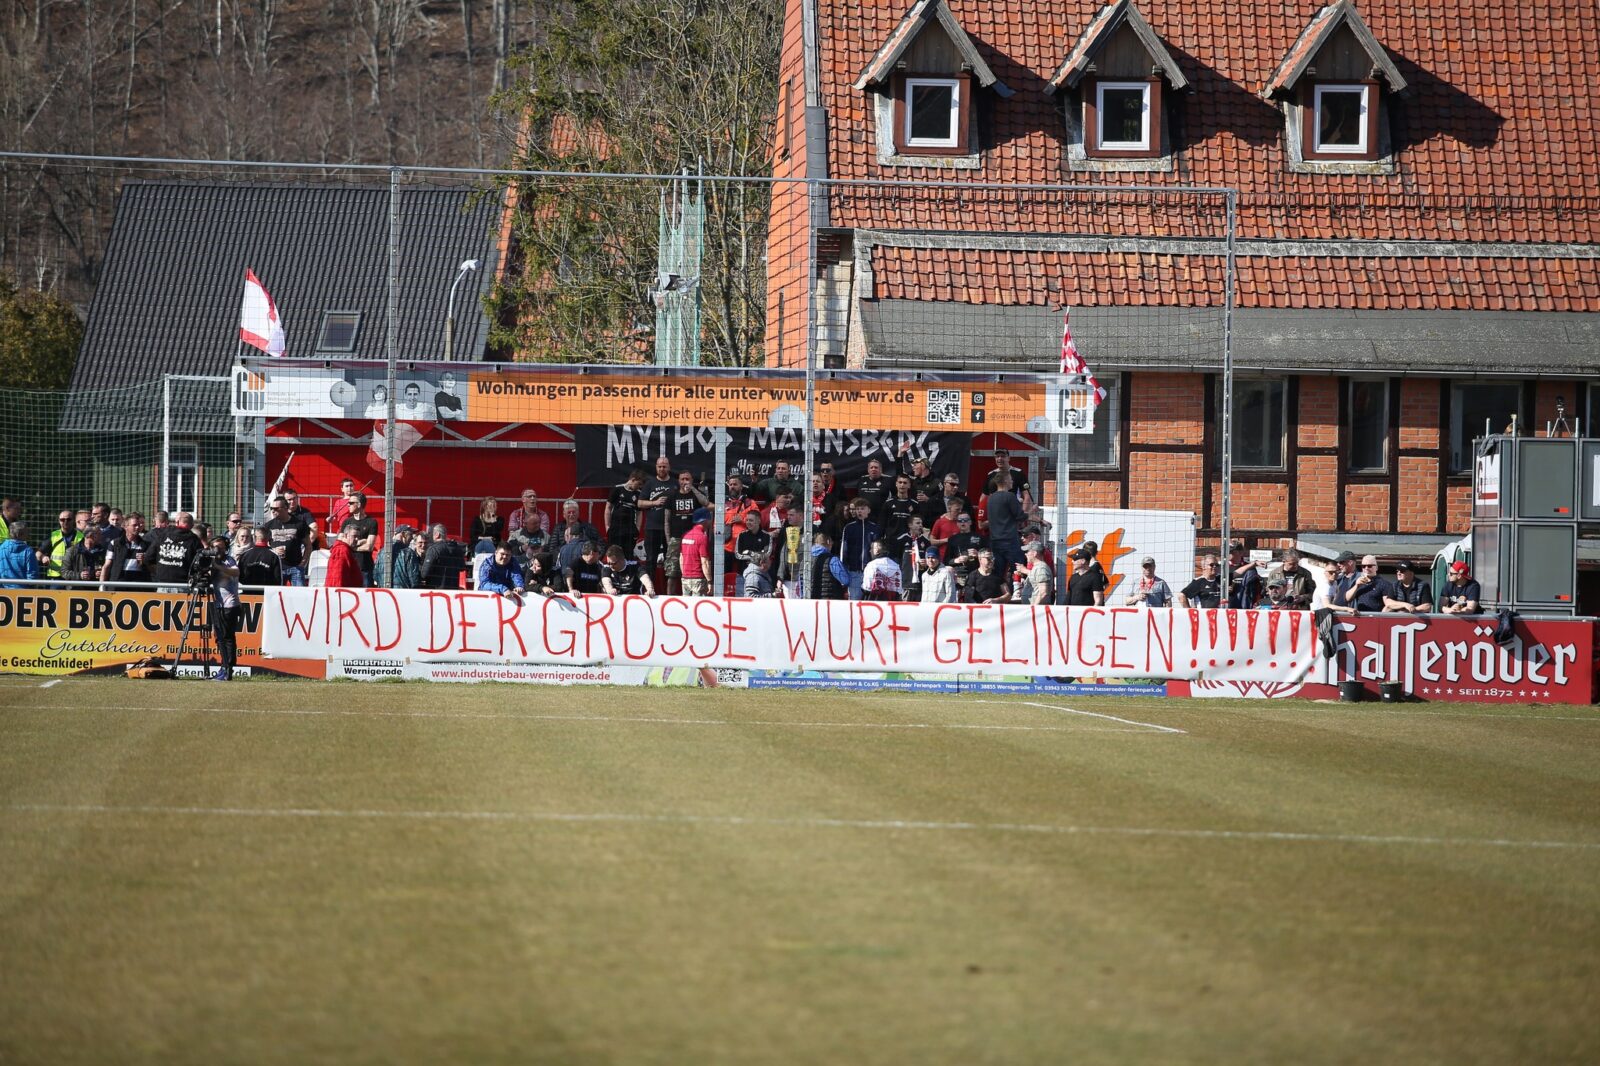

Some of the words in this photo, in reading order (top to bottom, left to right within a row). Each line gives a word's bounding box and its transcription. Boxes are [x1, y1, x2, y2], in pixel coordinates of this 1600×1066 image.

[477, 380, 578, 399] Wohnungen
[583, 384, 651, 399] passend
[656, 384, 680, 398] für
[685, 385, 715, 399] alle
[720, 387, 766, 400] unter
[621, 406, 648, 418] Hier
[653, 406, 690, 421] spielt
[694, 407, 715, 419] die
[718, 407, 770, 421] Zukunft
[278, 587, 402, 652] WIRD
[418, 590, 528, 657] DER
[542, 593, 756, 662] GROSSE
[780, 599, 920, 666] WURF
[40, 629, 163, 658] Gutscheine
[166, 645, 179, 654] für
[245, 647, 256, 656] im
[11, 656, 93, 669] Geschenkidee!
[344, 667, 403, 677] Wernigerode
[432, 669, 610, 681] www.industriebau-wernigerode.de
[1459, 688, 1482, 696] SEIT
[1484, 688, 1513, 697] 1872
